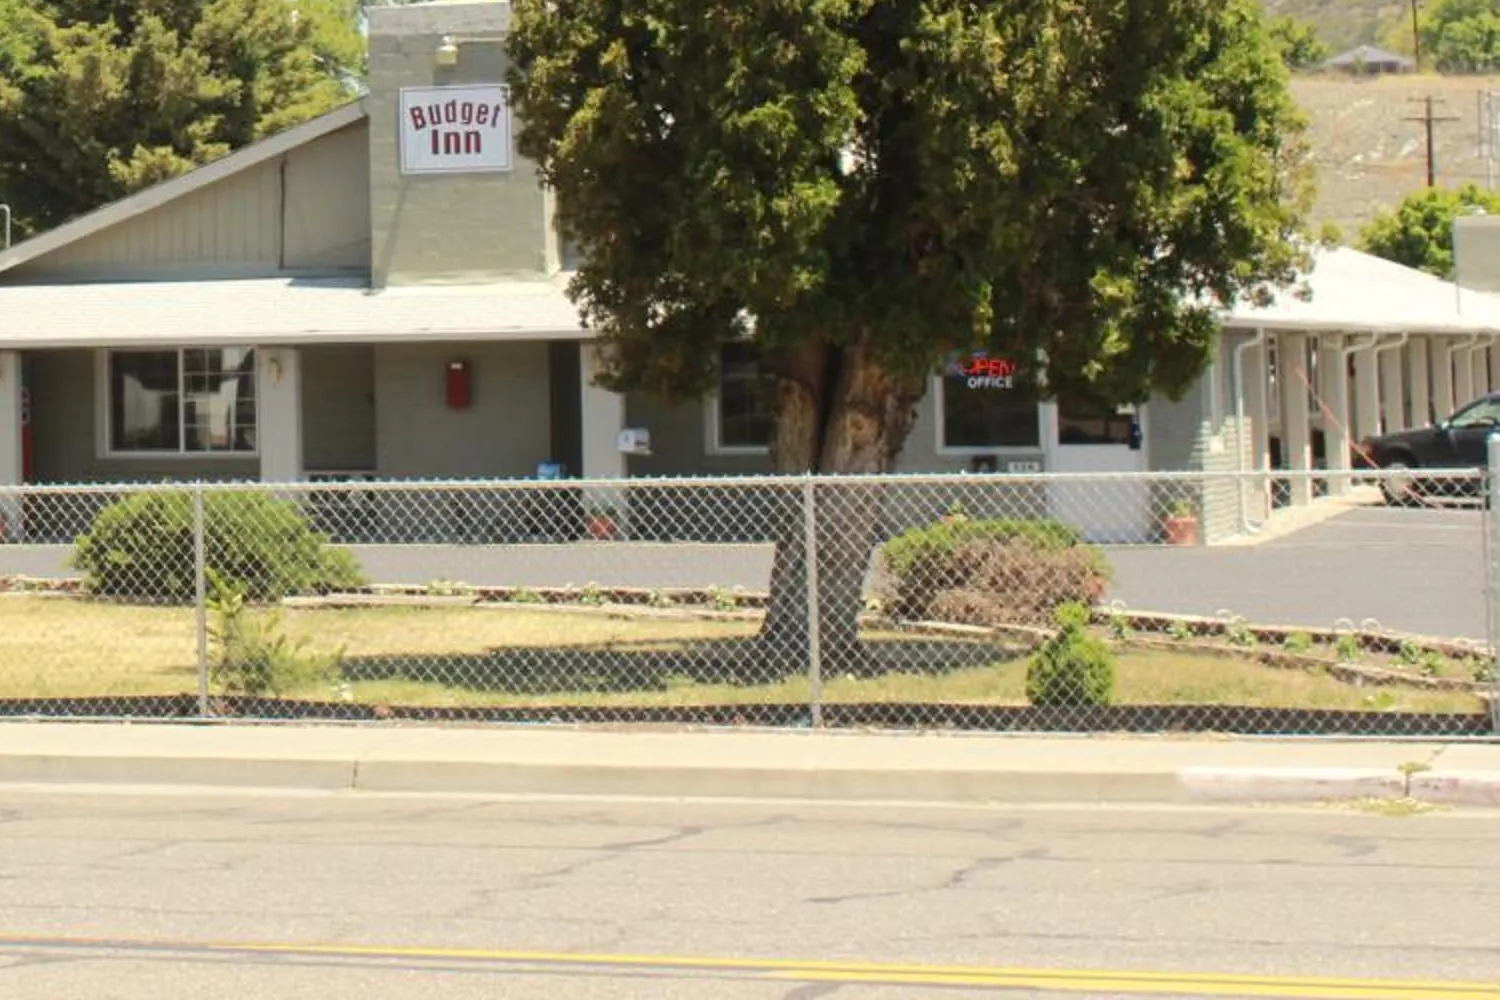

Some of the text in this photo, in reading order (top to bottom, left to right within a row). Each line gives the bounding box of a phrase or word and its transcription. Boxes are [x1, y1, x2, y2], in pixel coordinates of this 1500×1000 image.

[410, 99, 500, 131] Budget
[431, 129, 482, 155] Inn
[967, 376, 1013, 389] OFFICE
